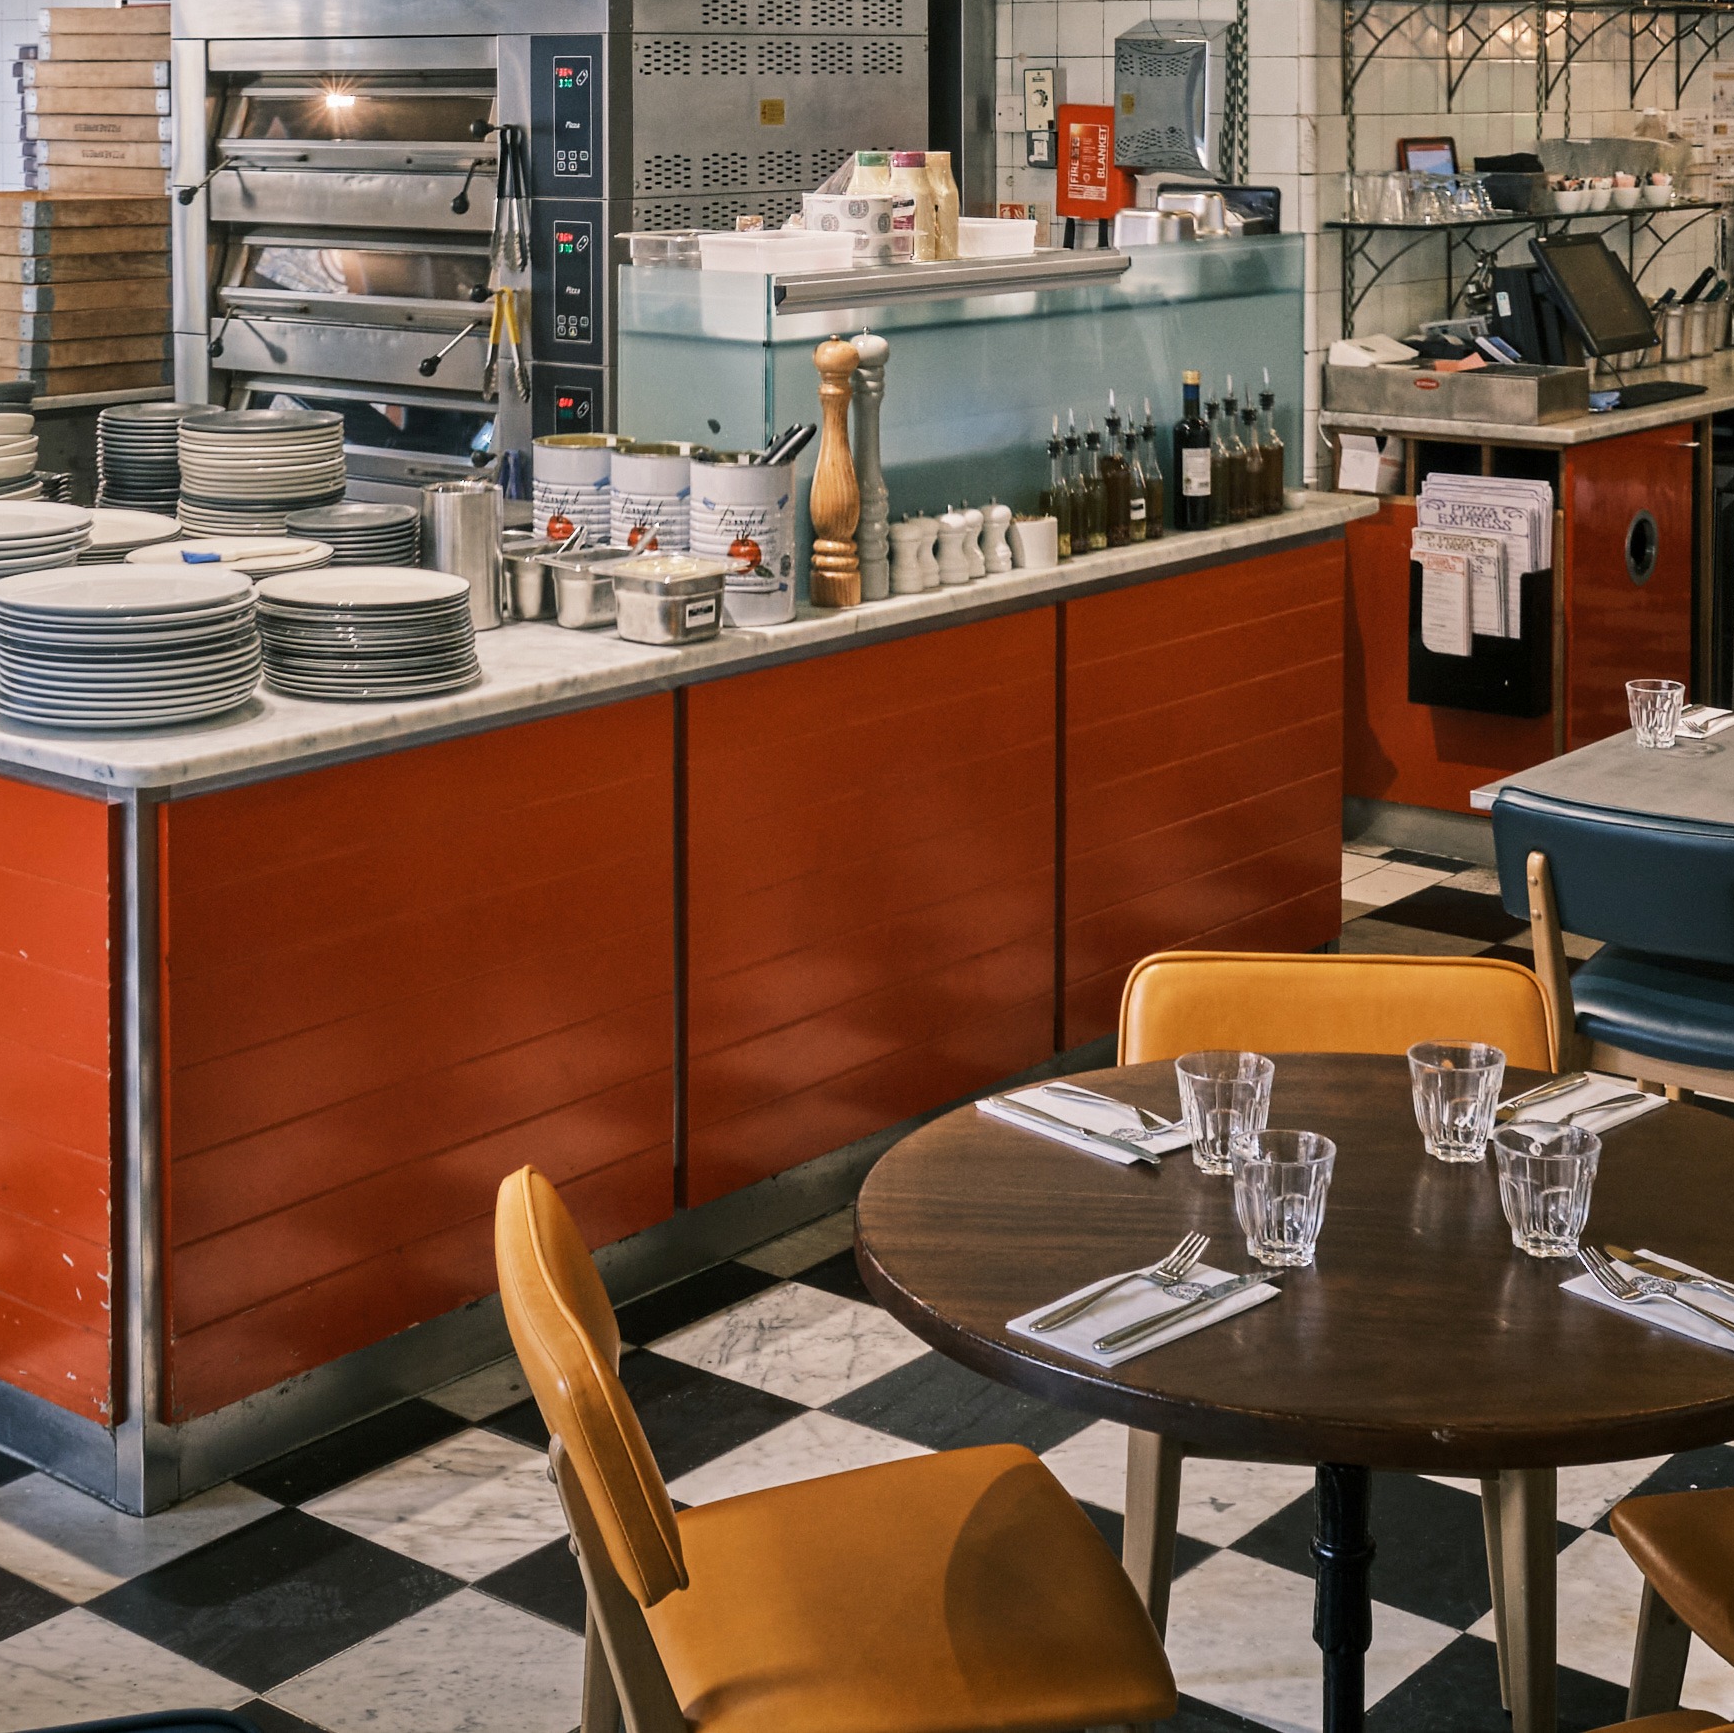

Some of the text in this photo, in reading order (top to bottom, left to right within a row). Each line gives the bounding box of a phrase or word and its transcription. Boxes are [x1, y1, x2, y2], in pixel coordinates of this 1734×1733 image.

[1096, 126, 1109, 179] BLANKET
[1070, 159, 1080, 184] FIRE
[1451, 503, 1499, 519] PIZZA
[1438, 513, 1512, 532] EXPRESS
